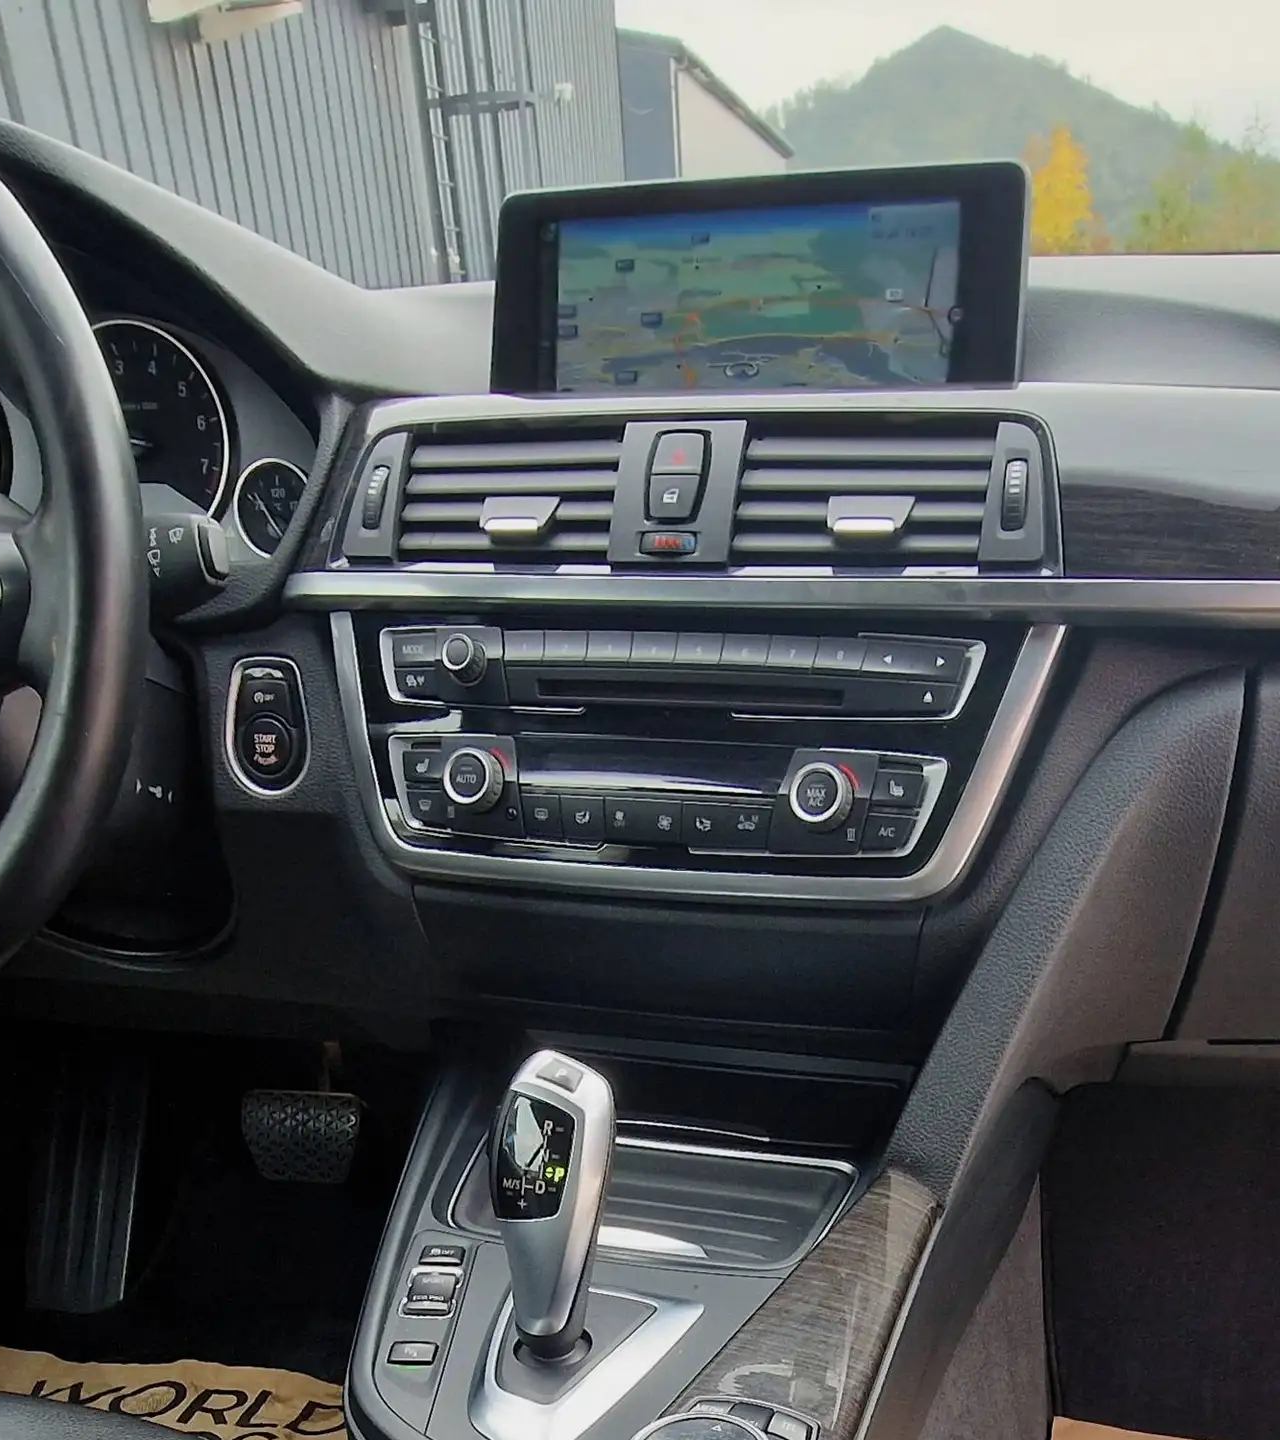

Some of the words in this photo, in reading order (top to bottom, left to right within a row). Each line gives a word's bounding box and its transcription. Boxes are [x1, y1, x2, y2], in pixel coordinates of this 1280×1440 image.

[115, 360, 124, 375] 3
[147, 360, 157, 375] 4
[177, 381, 187, 398] 5
[196, 415, 206, 431] 6
[200, 458, 209, 474] 7
[254, 734, 276, 743] START
[255, 744, 275, 753] STOP
[455, 775, 477, 784] AUTO
[806, 788, 826, 798] MAX
[807, 797, 825, 807] A/C
[878, 827, 896, 838] A/C
[556, 1068, 567, 1078] P
[543, 1120, 553, 1136] R
[535, 1180, 546, 1195] D
